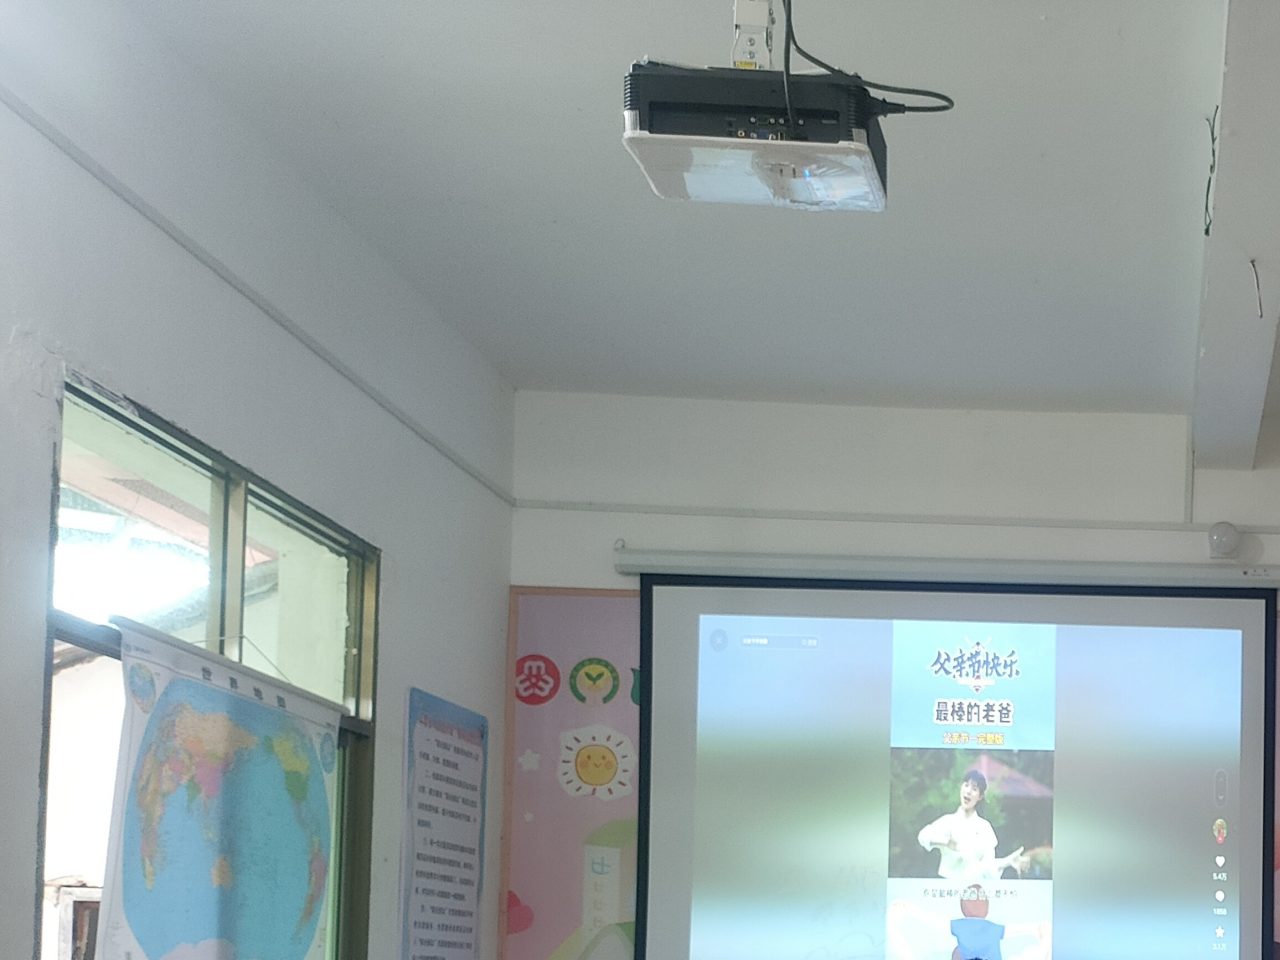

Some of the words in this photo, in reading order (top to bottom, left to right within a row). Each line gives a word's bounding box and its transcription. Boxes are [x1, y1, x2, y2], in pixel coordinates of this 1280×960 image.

[931, 648, 1020, 679] 父亲节快乐
[935, 701, 1011, 723] 最棒的老爸
